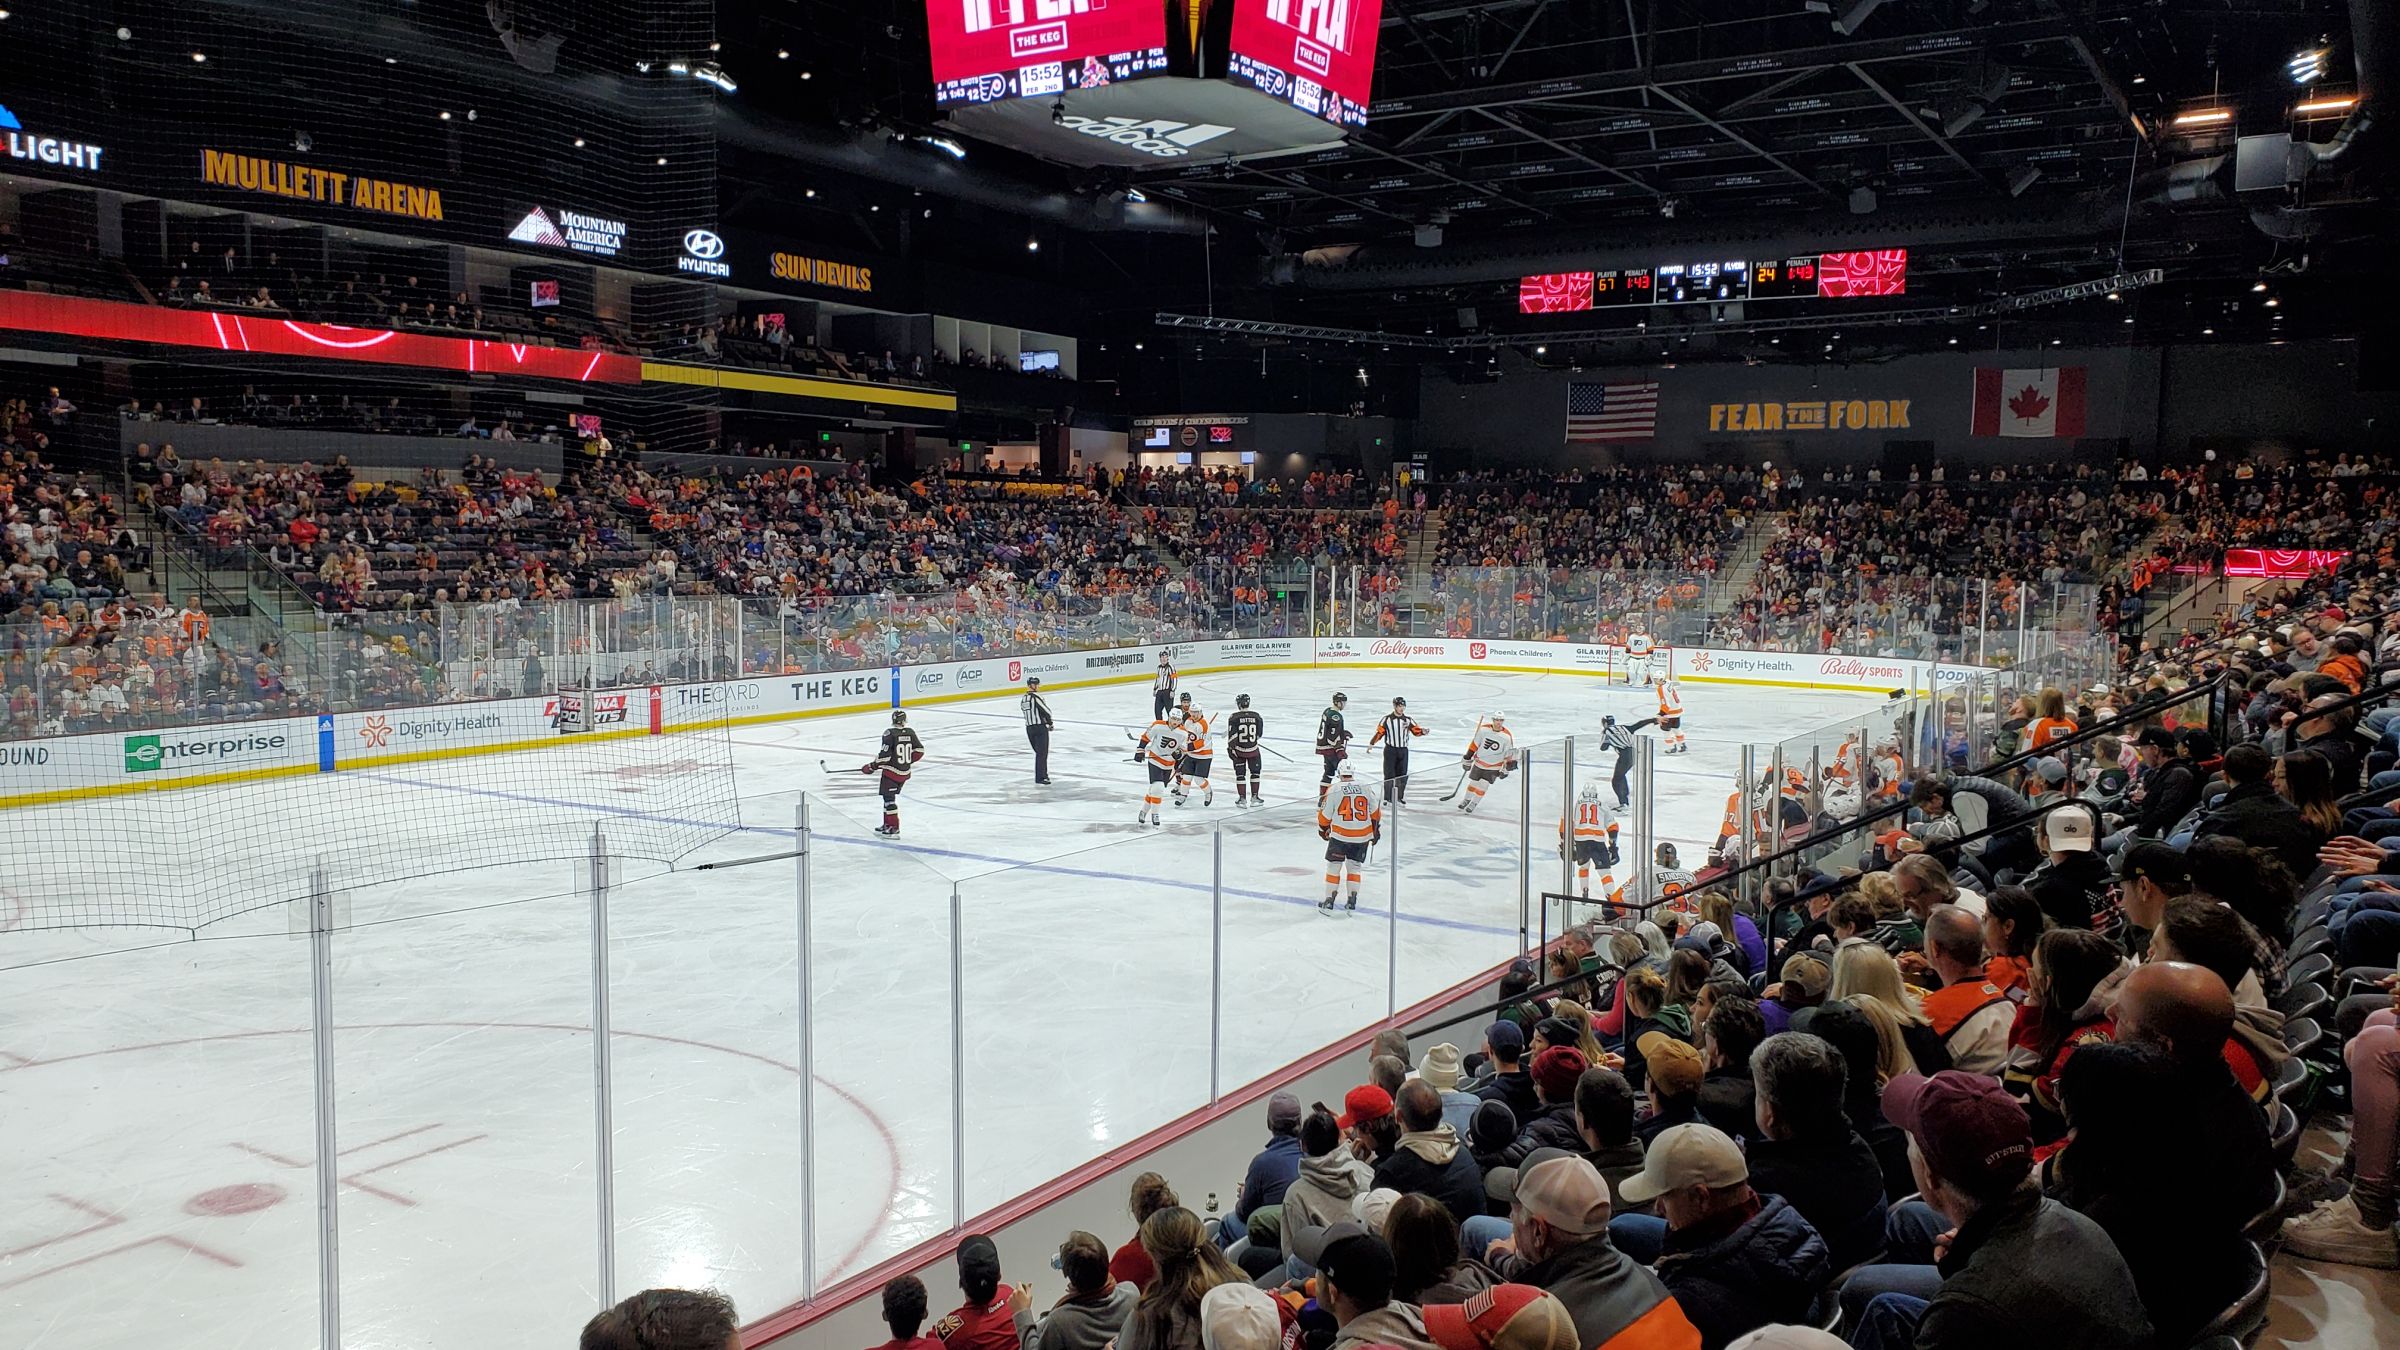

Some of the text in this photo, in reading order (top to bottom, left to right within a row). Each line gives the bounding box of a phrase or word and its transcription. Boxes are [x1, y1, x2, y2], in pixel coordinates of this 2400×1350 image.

[1016, 31, 1060, 48] THE KEG
[1109, 52, 1131, 63] SHOTS
[1148, 48, 1164, 57] PEN
[1300, 47, 1313, 60] THE
[1021, 64, 1061, 82] 15:52
[1114, 57, 1167, 78] 14 67 1:43
[1229, 61, 1265, 88] 24 1:43 12
[960, 77, 979, 87] SHOTS
[1068, 68, 1077, 84] 1
[1008, 78, 1017, 93] 1
[1044, 84, 1058, 92] 2ND
[1287, 82, 1293, 97] 1
[1296, 80, 1320, 100] 15:52
[938, 88, 979, 101] 24 1:43 12
[1322, 97, 1328, 112] 1
[1344, 111, 1352, 124] 14
[1054, 115, 1189, 157] adidas
[10, 132, 103, 170] LIGHT
[203, 148, 443, 221] MULLETT ARENA
[571, 242, 616, 256] CREDIT UNION
[679, 256, 730, 277] HYUNDAI
[1660, 265, 1684, 275] COYOTES
[1692, 263, 1718, 276] 15:52
[1724, 261, 1746, 272] FLYERS
[1756, 261, 1777, 269] PLAYER
[1786, 258, 1812, 267] PENALTY
[771, 251, 872, 292] SUN DEVILS
[1597, 271, 1617, 279] PLAYER
[1625, 269, 1648, 277] PENALTY
[1758, 268, 1776, 282] 24
[1787, 266, 1814, 280] 1:43
[1599, 278, 1615, 291] 67
[1626, 275, 1650, 289] 1:43
[1671, 276, 1676, 286] 1
[1704, 276, 1711, 286] 2
[1709, 398, 1911, 433] FEAR THE FORK
[1369, 639, 1444, 659] Bally SPORTS
[1489, 648, 1553, 658] Phoenix Children's
[1023, 663, 1069, 674] Phoenix Children's
[1717, 657, 1753, 672] Dignity
[1820, 657, 1903, 681] Bally SPORTS
[920, 673, 943, 684] ACP
[960, 669, 982, 680] ACP
[791, 676, 879, 700] THE KEG
[731, 704, 759, 712] CASINOS
[399, 712, 500, 738] Dignity Health
[1238, 724, 1257, 743] 29
[136, 732, 286, 763] enterprise
[896, 743, 913, 764] 90
[1337, 795, 1368, 821] 49
[1579, 803, 1599, 826] 11
[2064, 824, 2077, 833] alo
